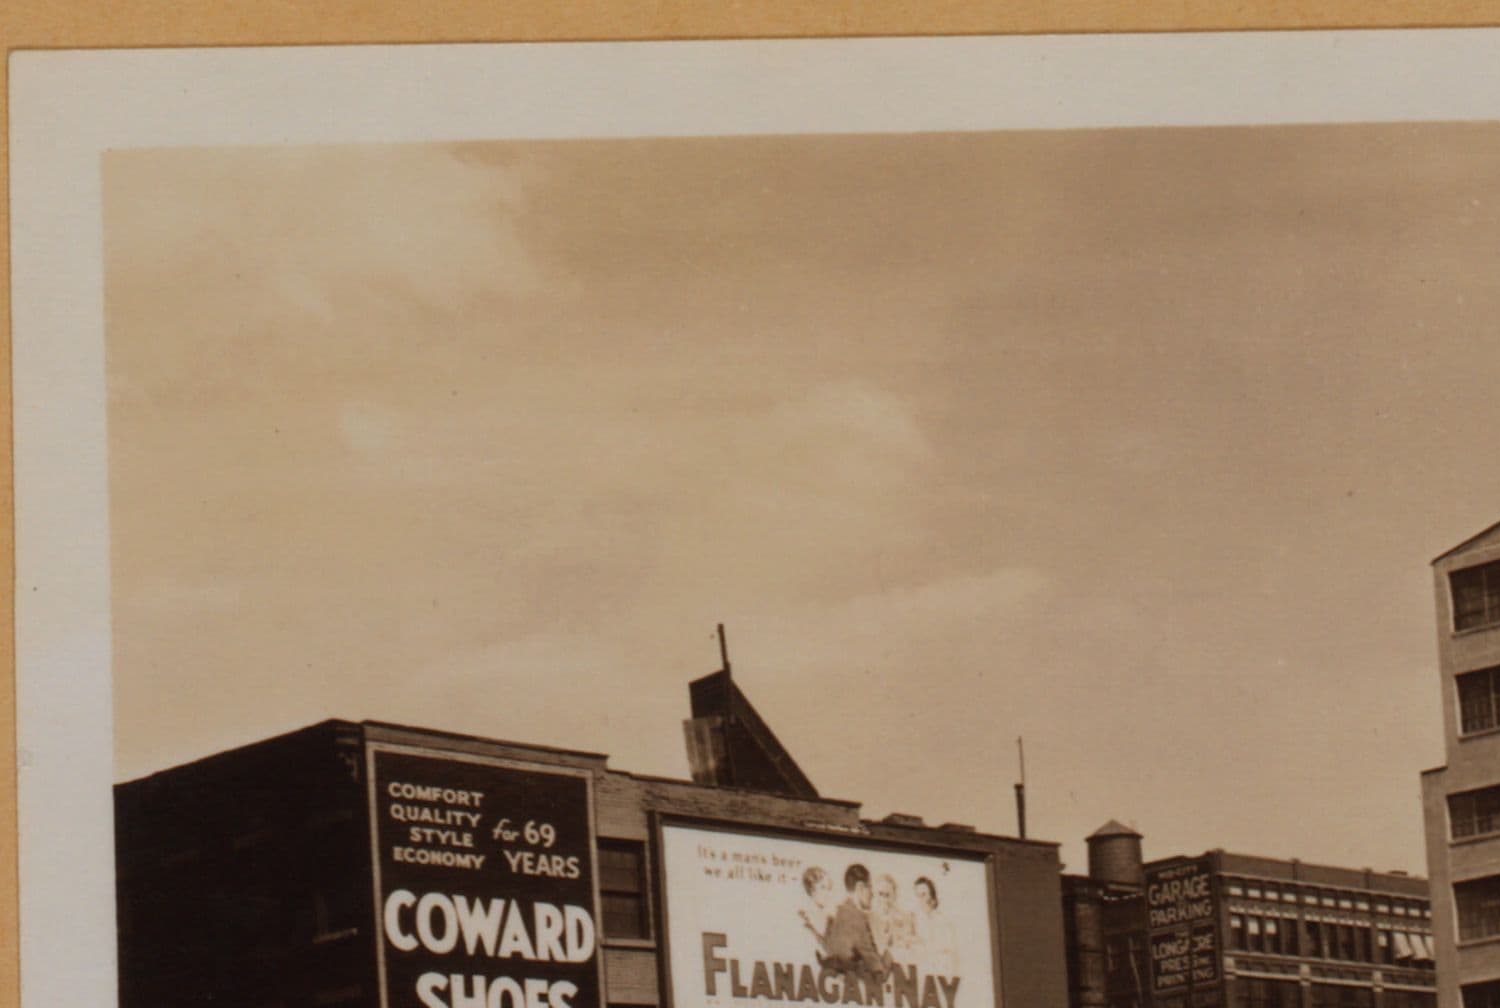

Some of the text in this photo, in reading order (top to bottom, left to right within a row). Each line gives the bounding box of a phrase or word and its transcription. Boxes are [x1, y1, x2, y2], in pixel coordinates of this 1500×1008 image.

[387, 781, 485, 807] COMFORT
[390, 803, 482, 828] QUALITY
[409, 827, 473, 848] STYLE
[492, 818, 556, 848] for 69
[393, 846, 485, 870] ECONOMY
[503, 850, 580, 879] YEARS
[1148, 873, 1211, 905] GARAGE
[384, 888, 595, 963] COWARD
[1150, 899, 1213, 927] PARKING
